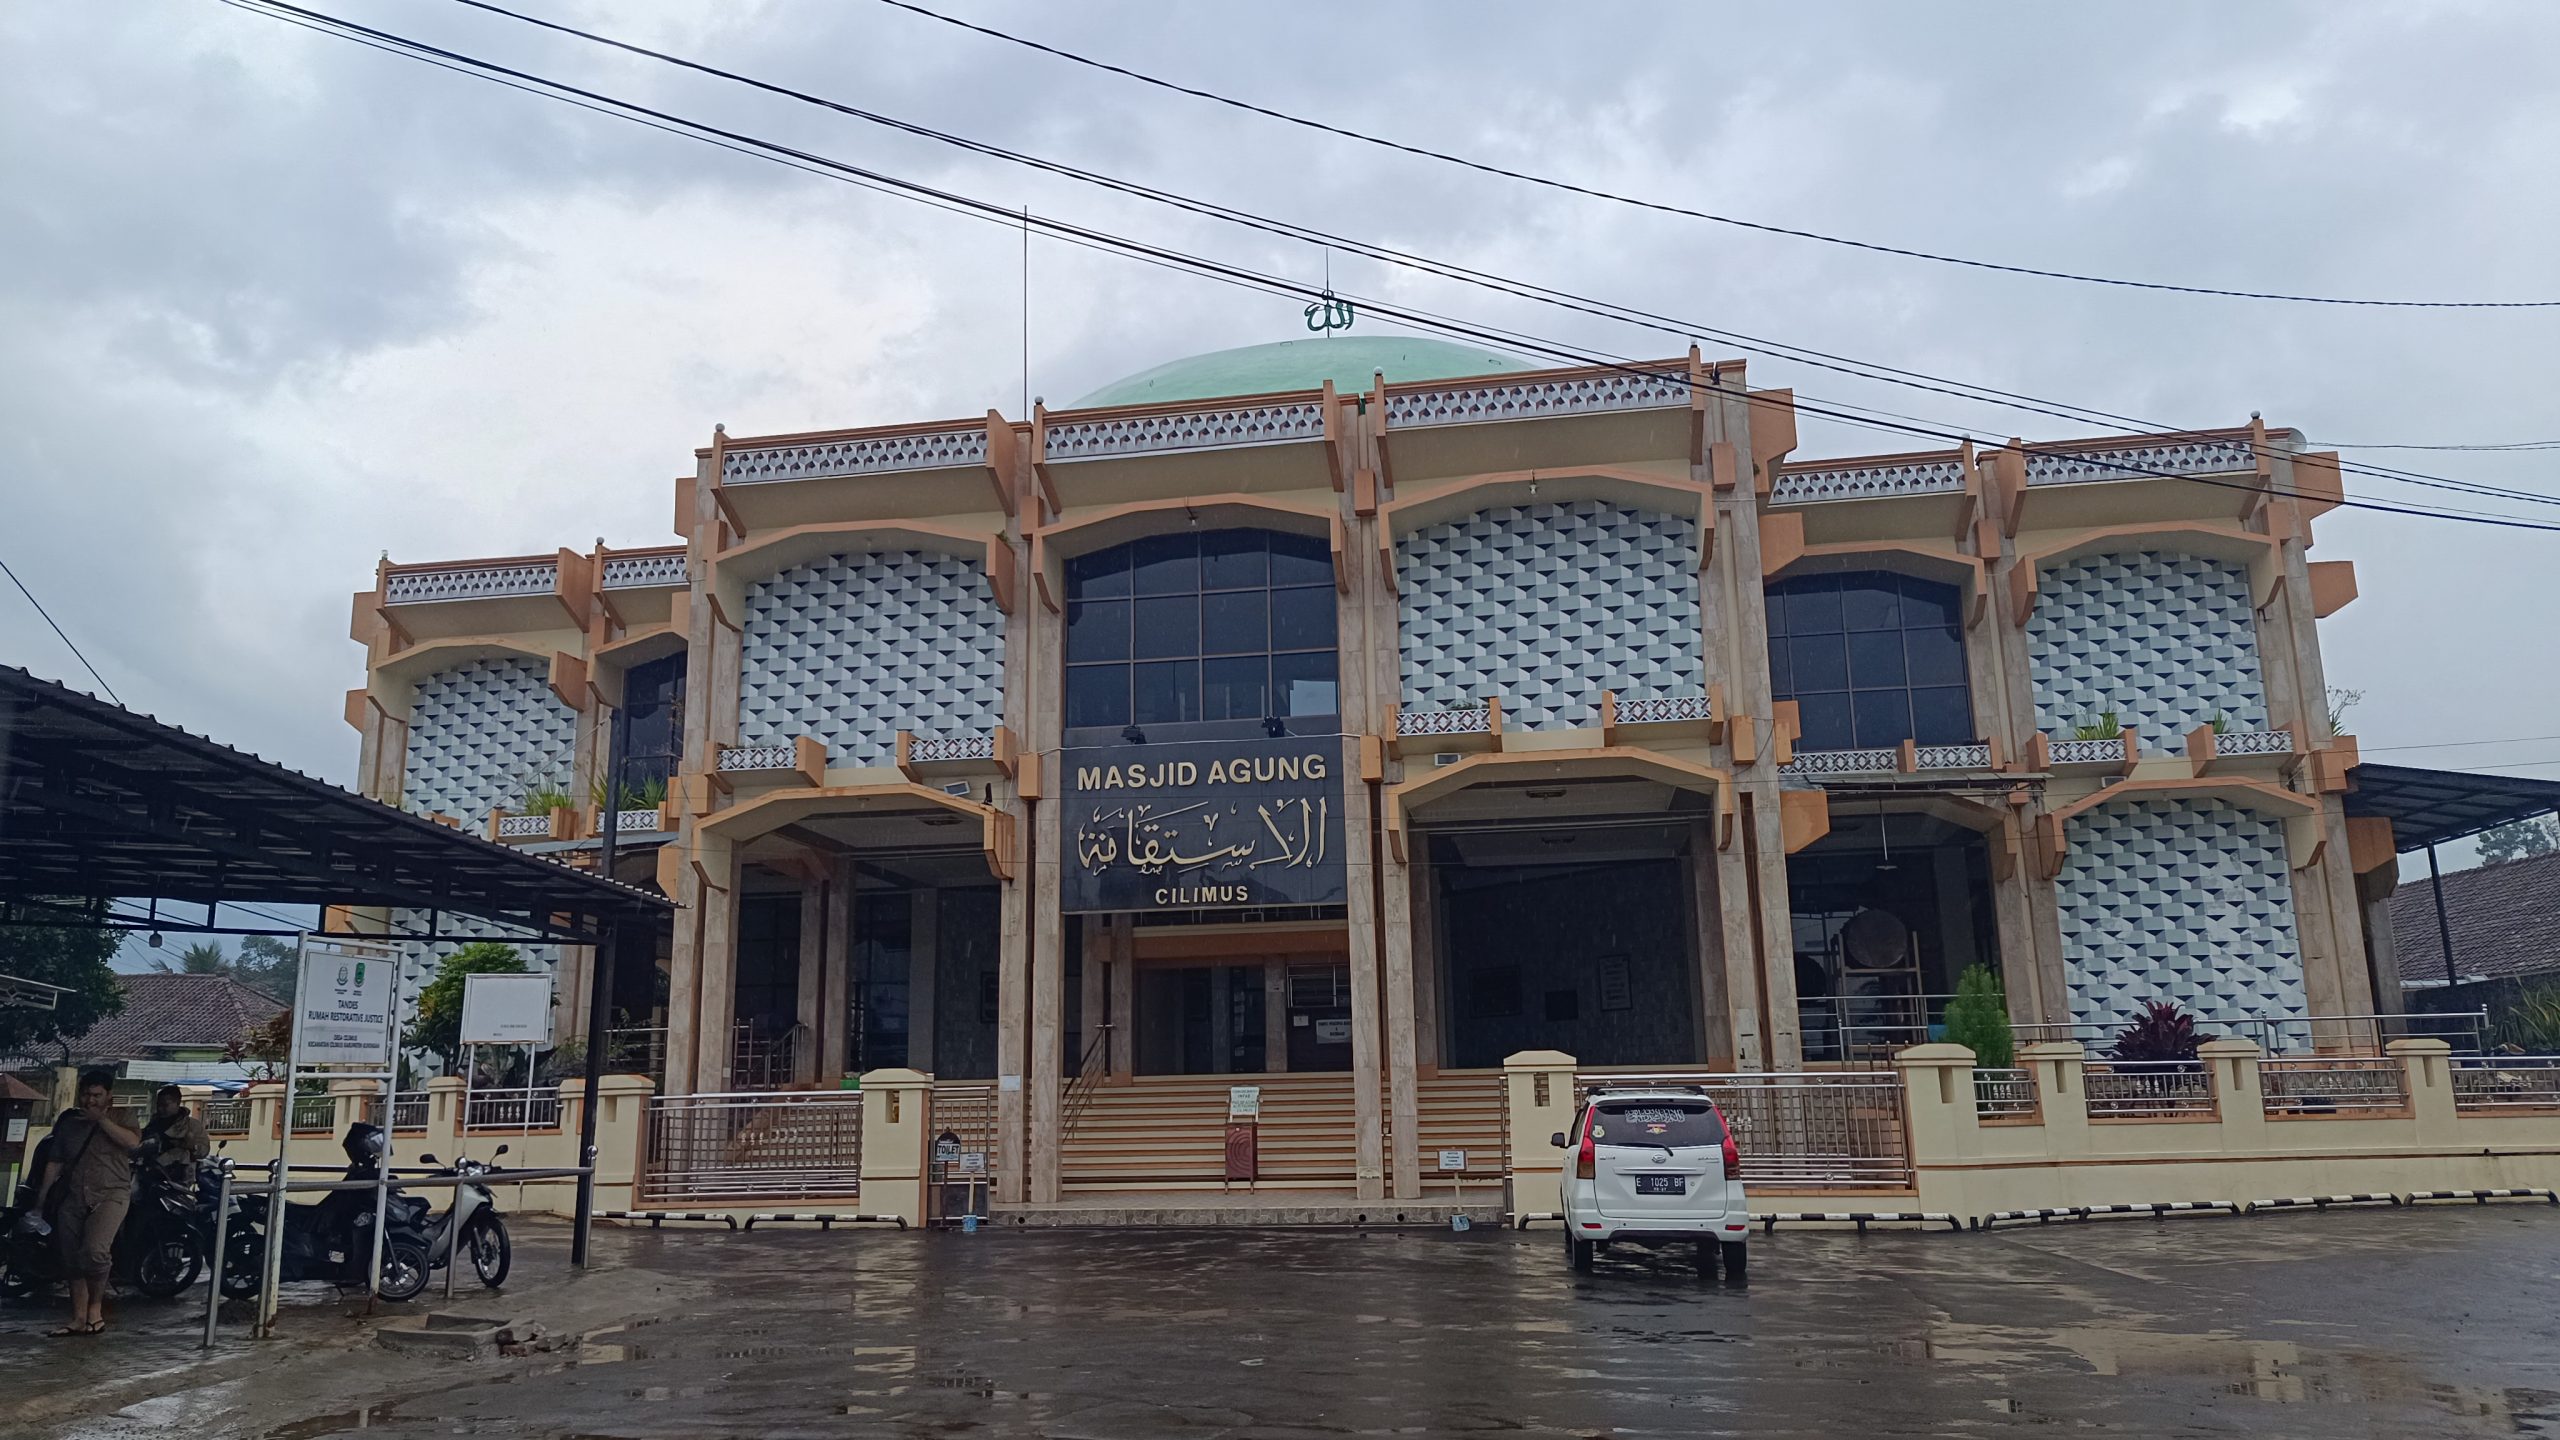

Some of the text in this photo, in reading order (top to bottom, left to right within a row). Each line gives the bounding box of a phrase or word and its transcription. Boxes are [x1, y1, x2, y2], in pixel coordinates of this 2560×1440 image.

[1077, 754, 1327, 792] MASJID AGUNG
[1155, 885, 1249, 905] CILIMUS
[338, 999, 359, 1009] TANDES
[308, 1010, 384, 1023] RUMAH RESTORATIVE JUSTICE
[937, 1145, 960, 1155] TOILET
[1636, 1177, 1684, 1187] E 1025 BF
